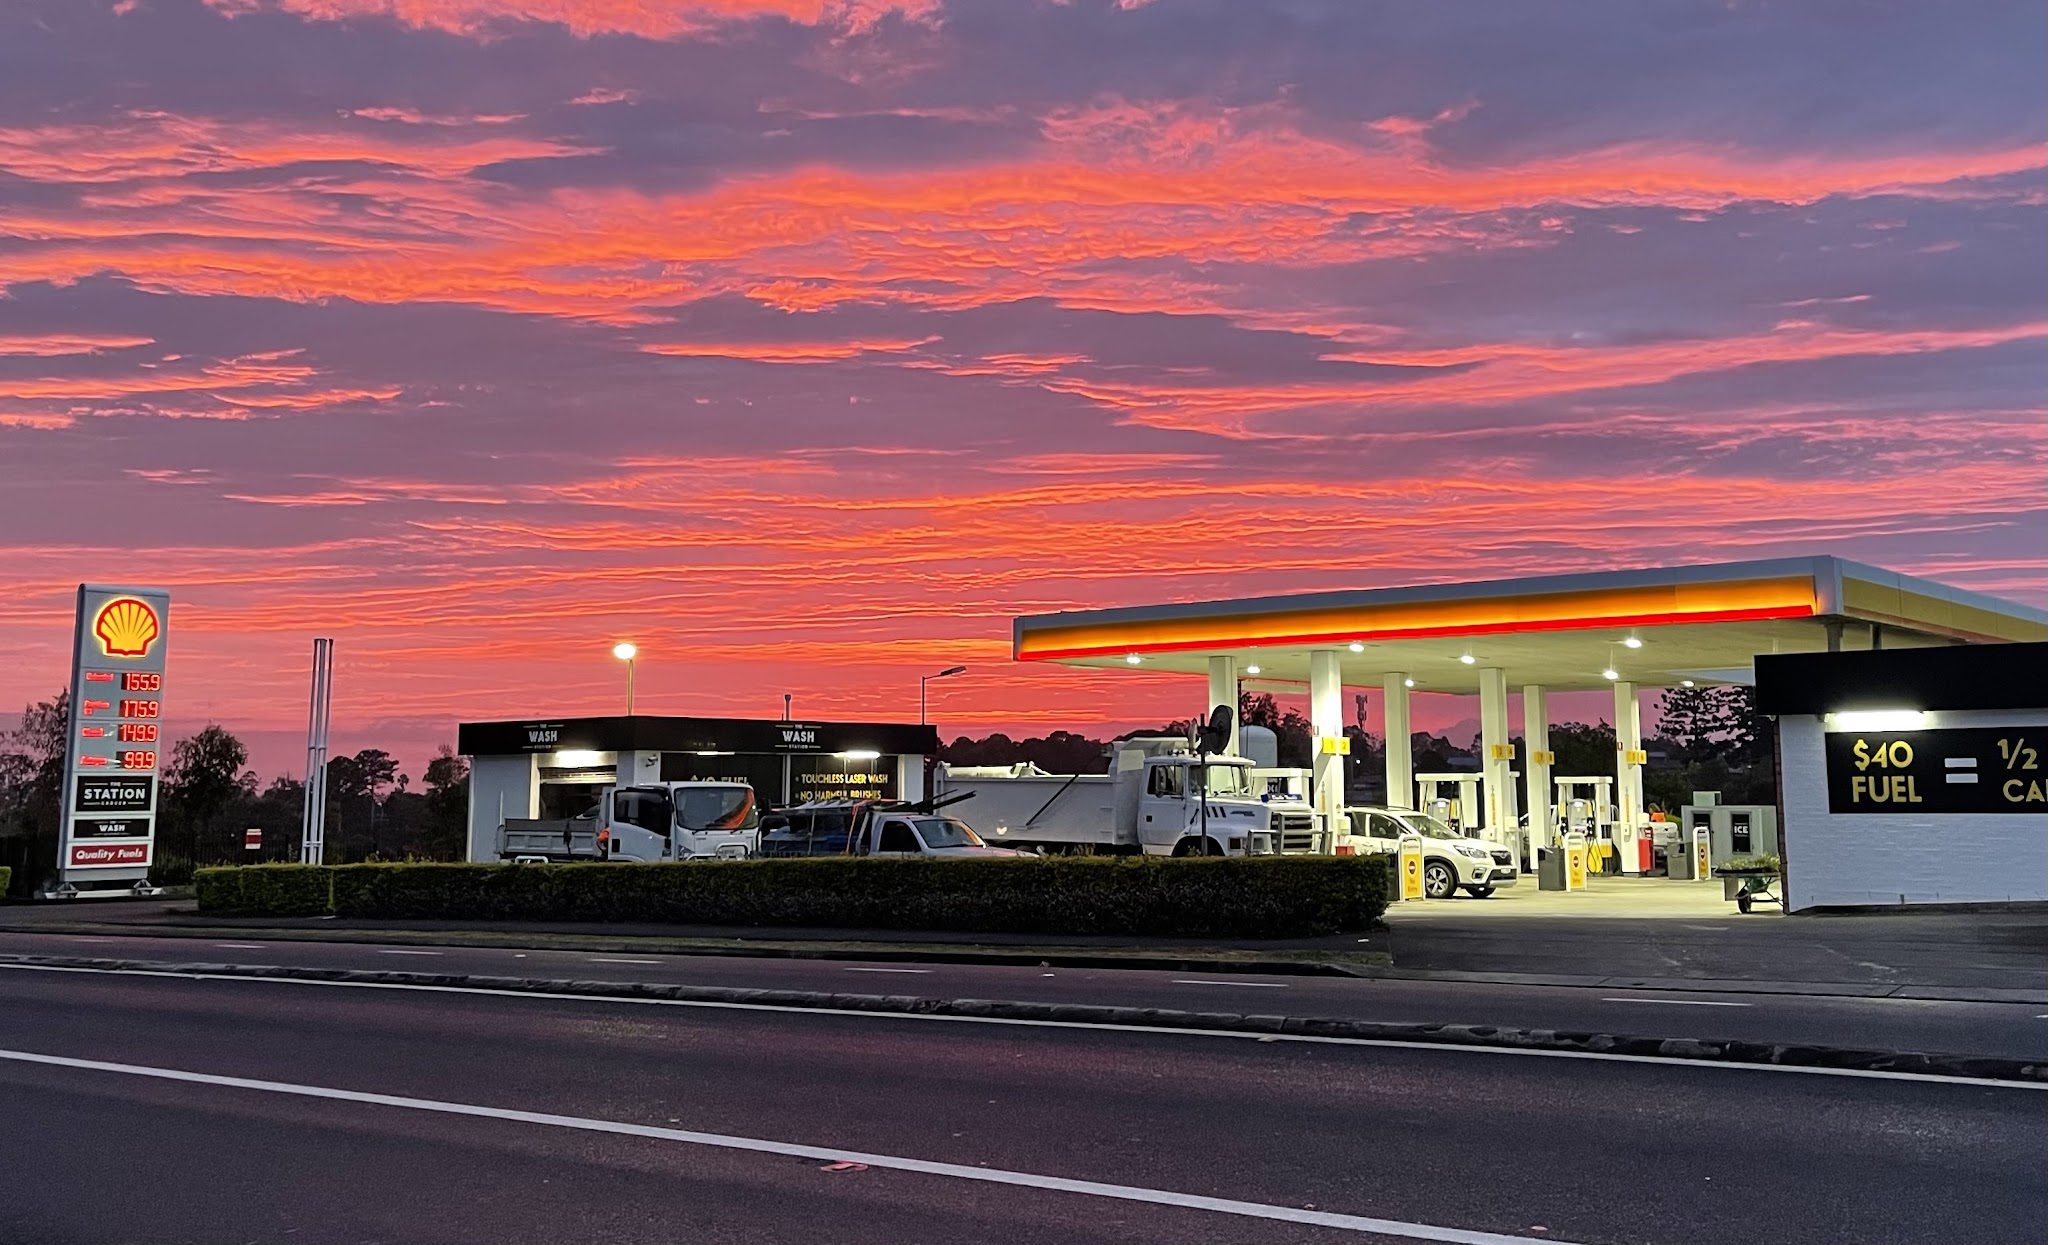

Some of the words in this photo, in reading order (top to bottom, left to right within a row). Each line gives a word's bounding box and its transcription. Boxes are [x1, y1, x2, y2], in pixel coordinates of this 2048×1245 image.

[529, 731, 557, 742] WASH
[782, 731, 815, 742] WASH
[124, 752, 155, 768] 99.9
[1853, 739, 1914, 771] $40
[801, 774, 844, 784] TOUCHLESS
[845, 774, 867, 784] LASER
[867, 774, 888, 784] WASH
[84, 788, 145, 799] STATION
[1852, 775, 1922, 803] FUEL
[2003, 779, 2048, 802] CA
[800, 790, 813, 800] NO
[1734, 826, 1748, 834] ICE
[76, 849, 115, 861] Quality
[117, 848, 143, 858] Fuels
